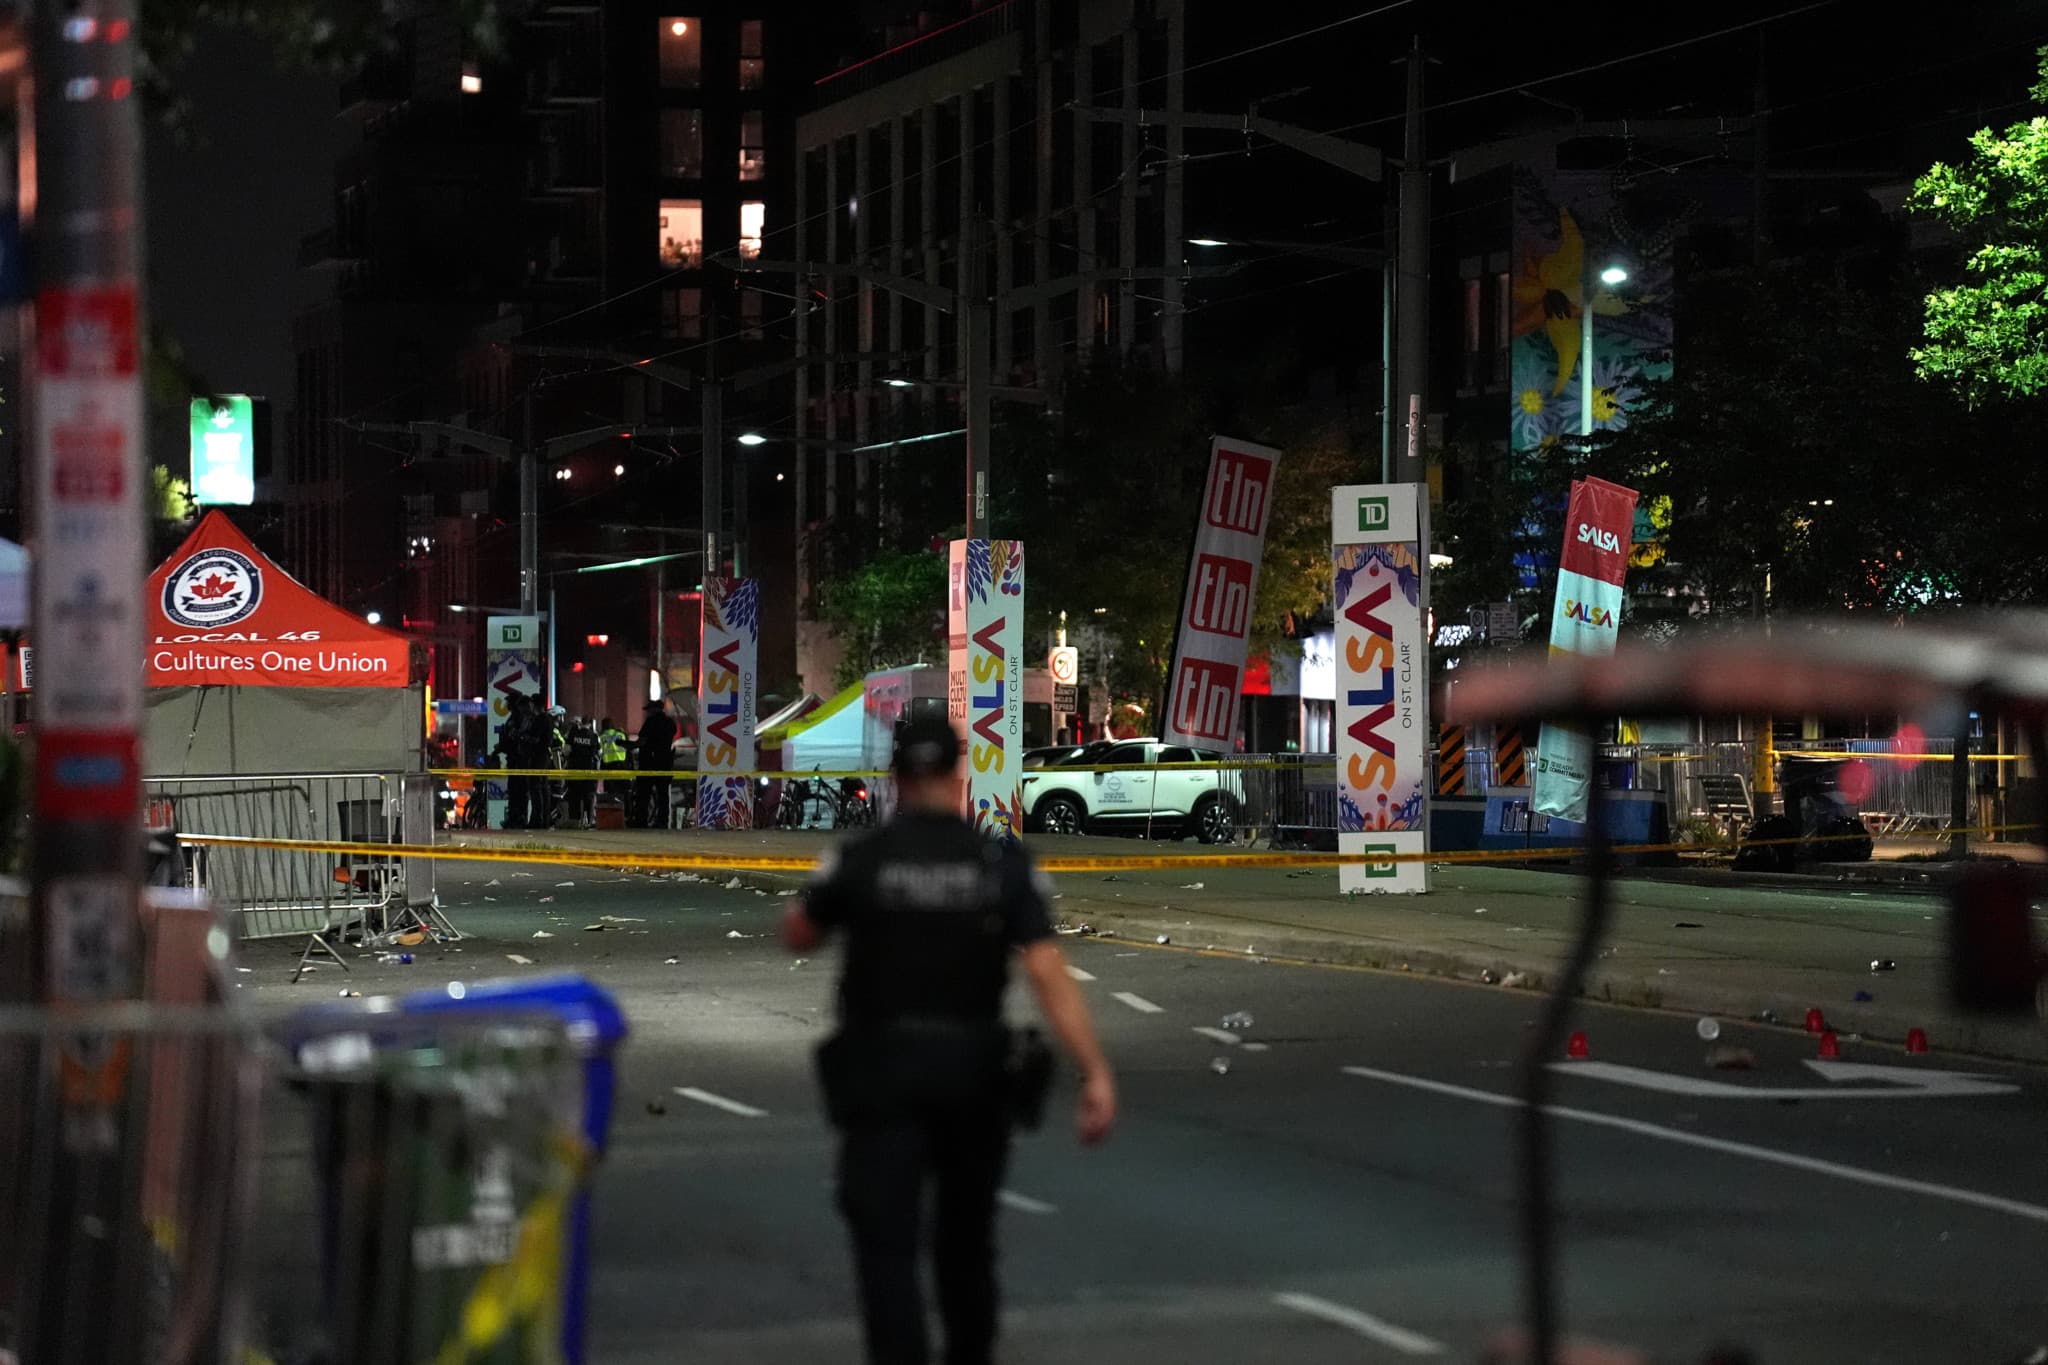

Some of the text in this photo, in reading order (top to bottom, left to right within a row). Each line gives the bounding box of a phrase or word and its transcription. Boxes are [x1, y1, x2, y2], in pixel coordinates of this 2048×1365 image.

[1211, 458, 1265, 531] tln
[1361, 503, 1386, 524] TD
[1577, 523, 1621, 554] SALSA
[201, 586, 222, 597] UA
[1193, 562, 1247, 635] tln
[1563, 599, 1613, 629] SALSA
[153, 651, 255, 672] Cultures
[261, 651, 312, 671] One
[318, 652, 388, 672] Union
[155, 631, 321, 644] LOCAL 46
[504, 627, 520, 639] TD
[706, 639, 740, 768] SALSA
[743, 672, 753, 736] IN TORONTO
[972, 616, 1006, 775] SALSA
[1009, 656, 1019, 736] ON ST. CLAIR
[1177, 665, 1231, 738] tln
[1345, 582, 1396, 791] SALSA
[1400, 643, 1412, 728] ON ST. CLAIR
[573, 736, 591, 745] POLICE
